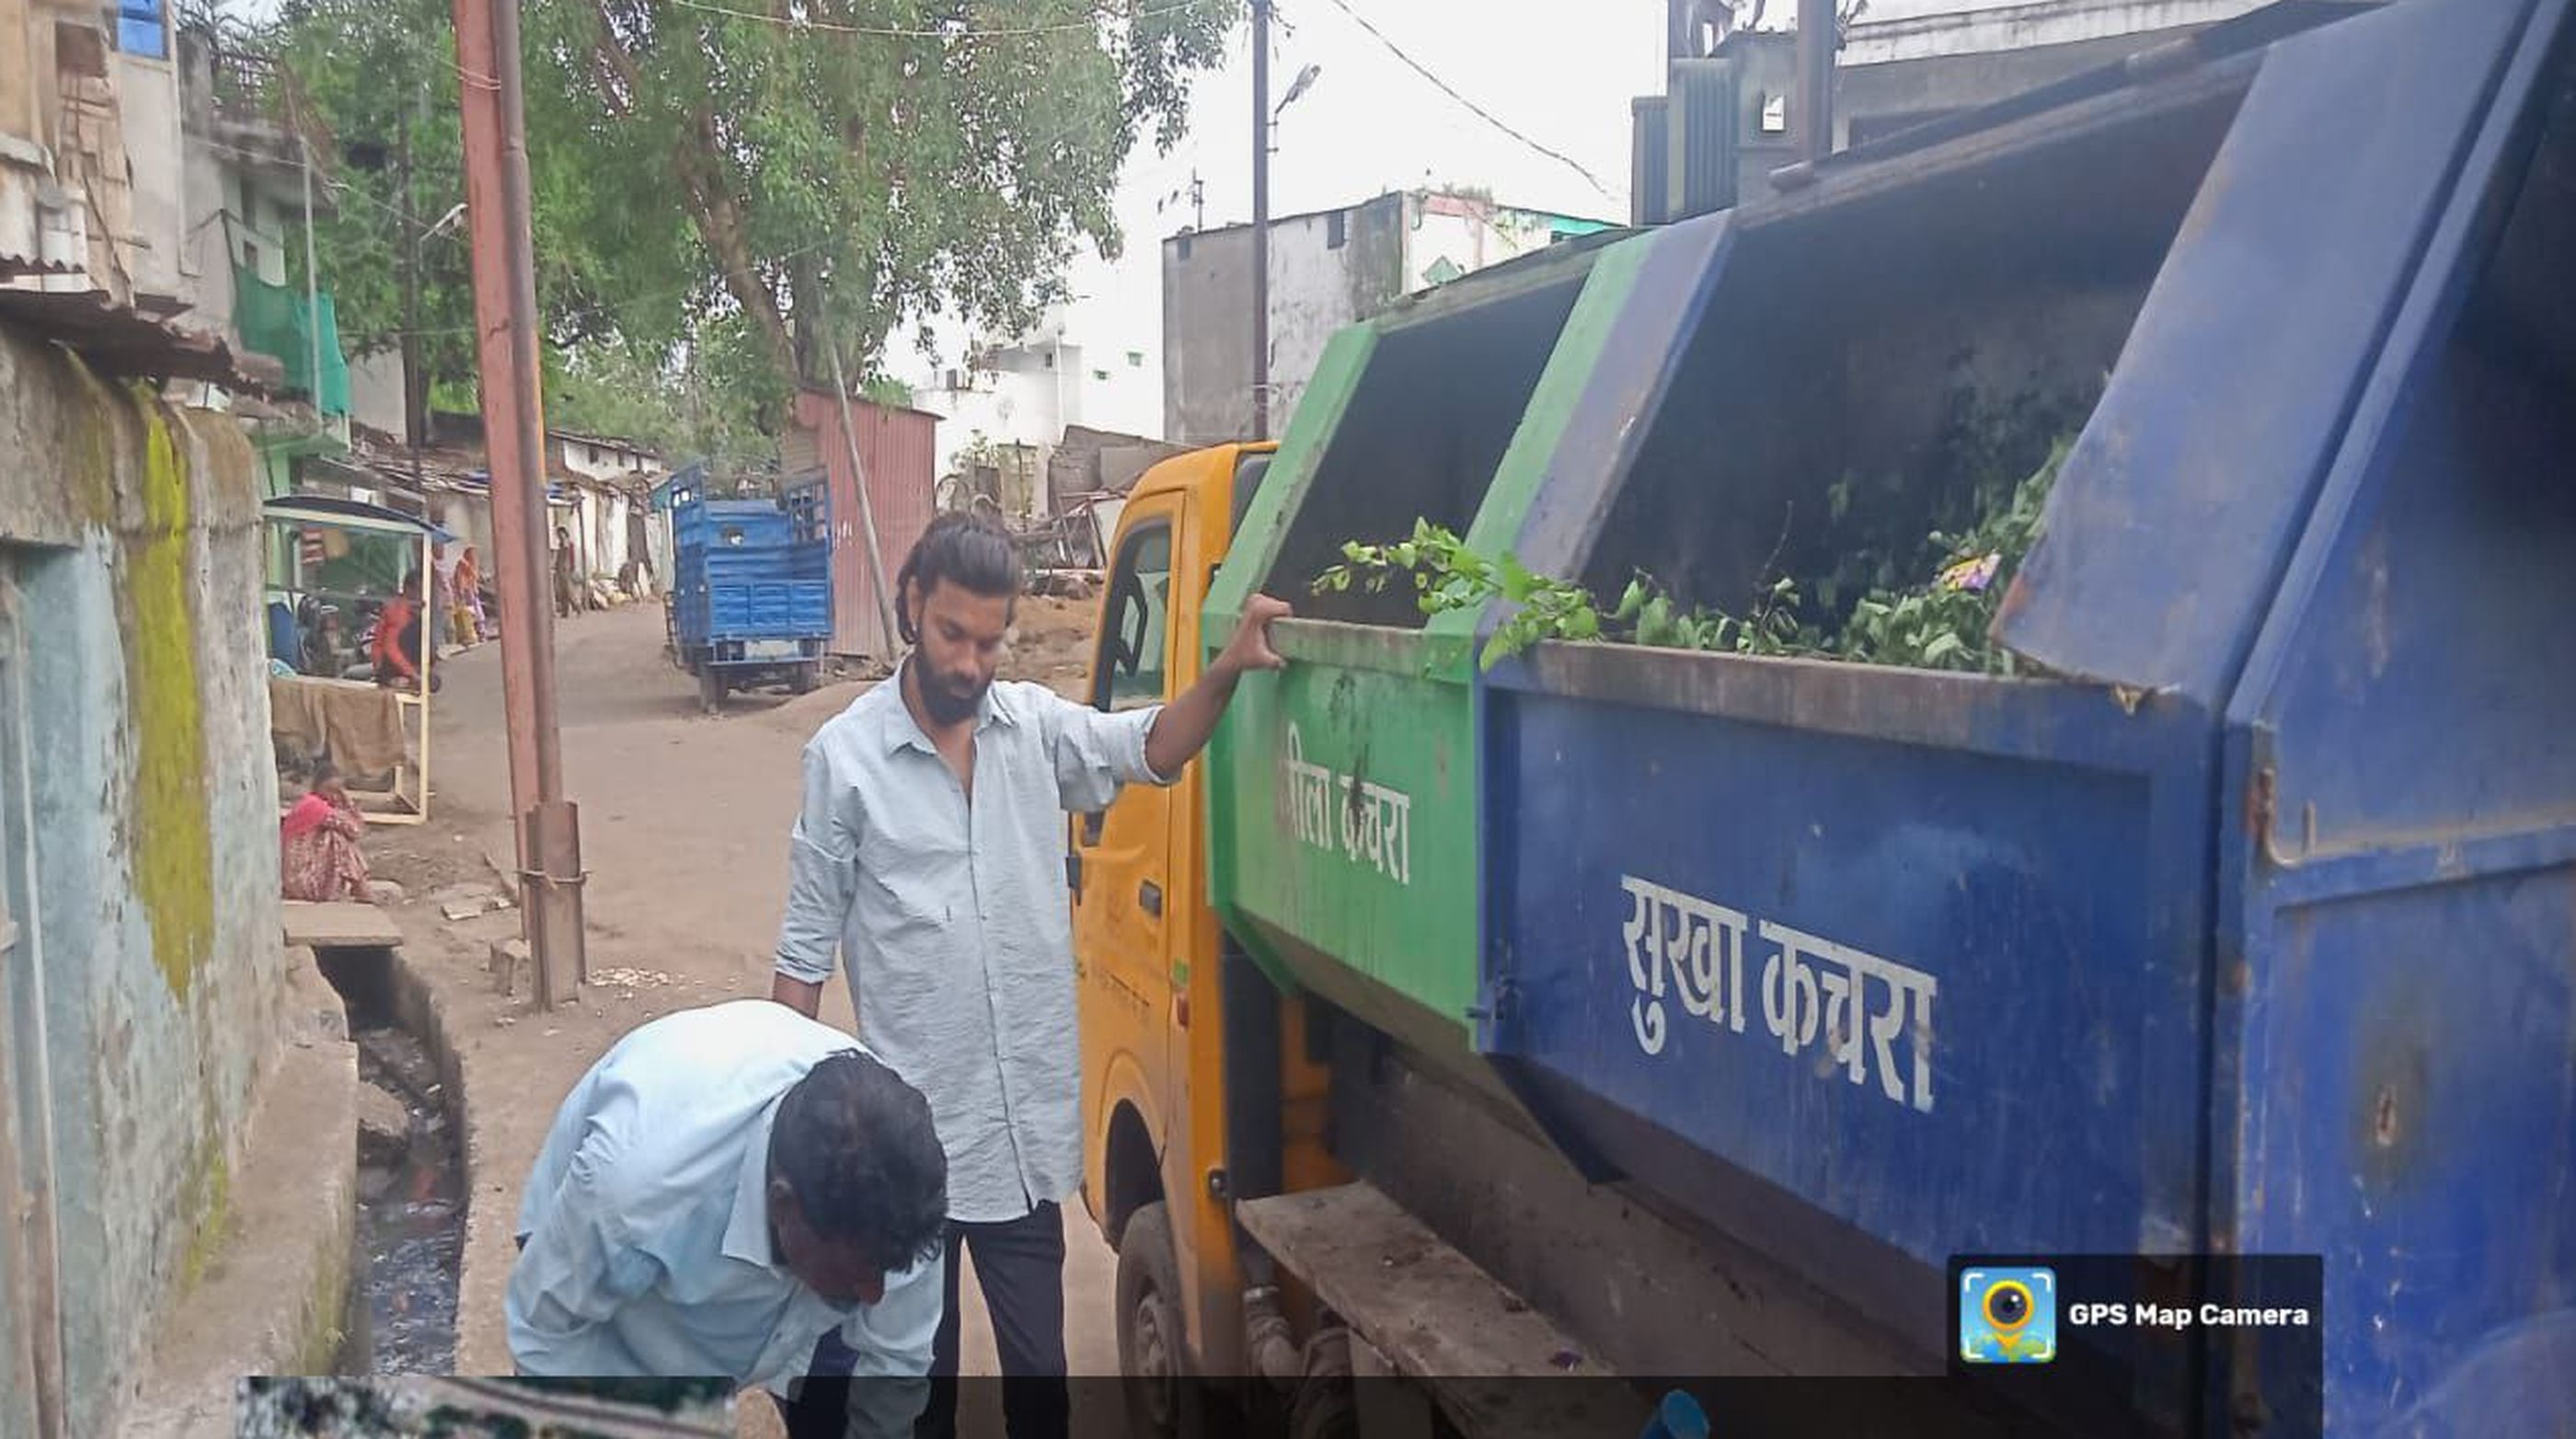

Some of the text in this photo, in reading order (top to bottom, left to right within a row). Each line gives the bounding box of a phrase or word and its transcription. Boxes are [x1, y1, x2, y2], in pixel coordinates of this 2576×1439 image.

[1339, 774, 1409, 885] कचरा
[1621, 873, 1937, 1114] सुखा कचरा
